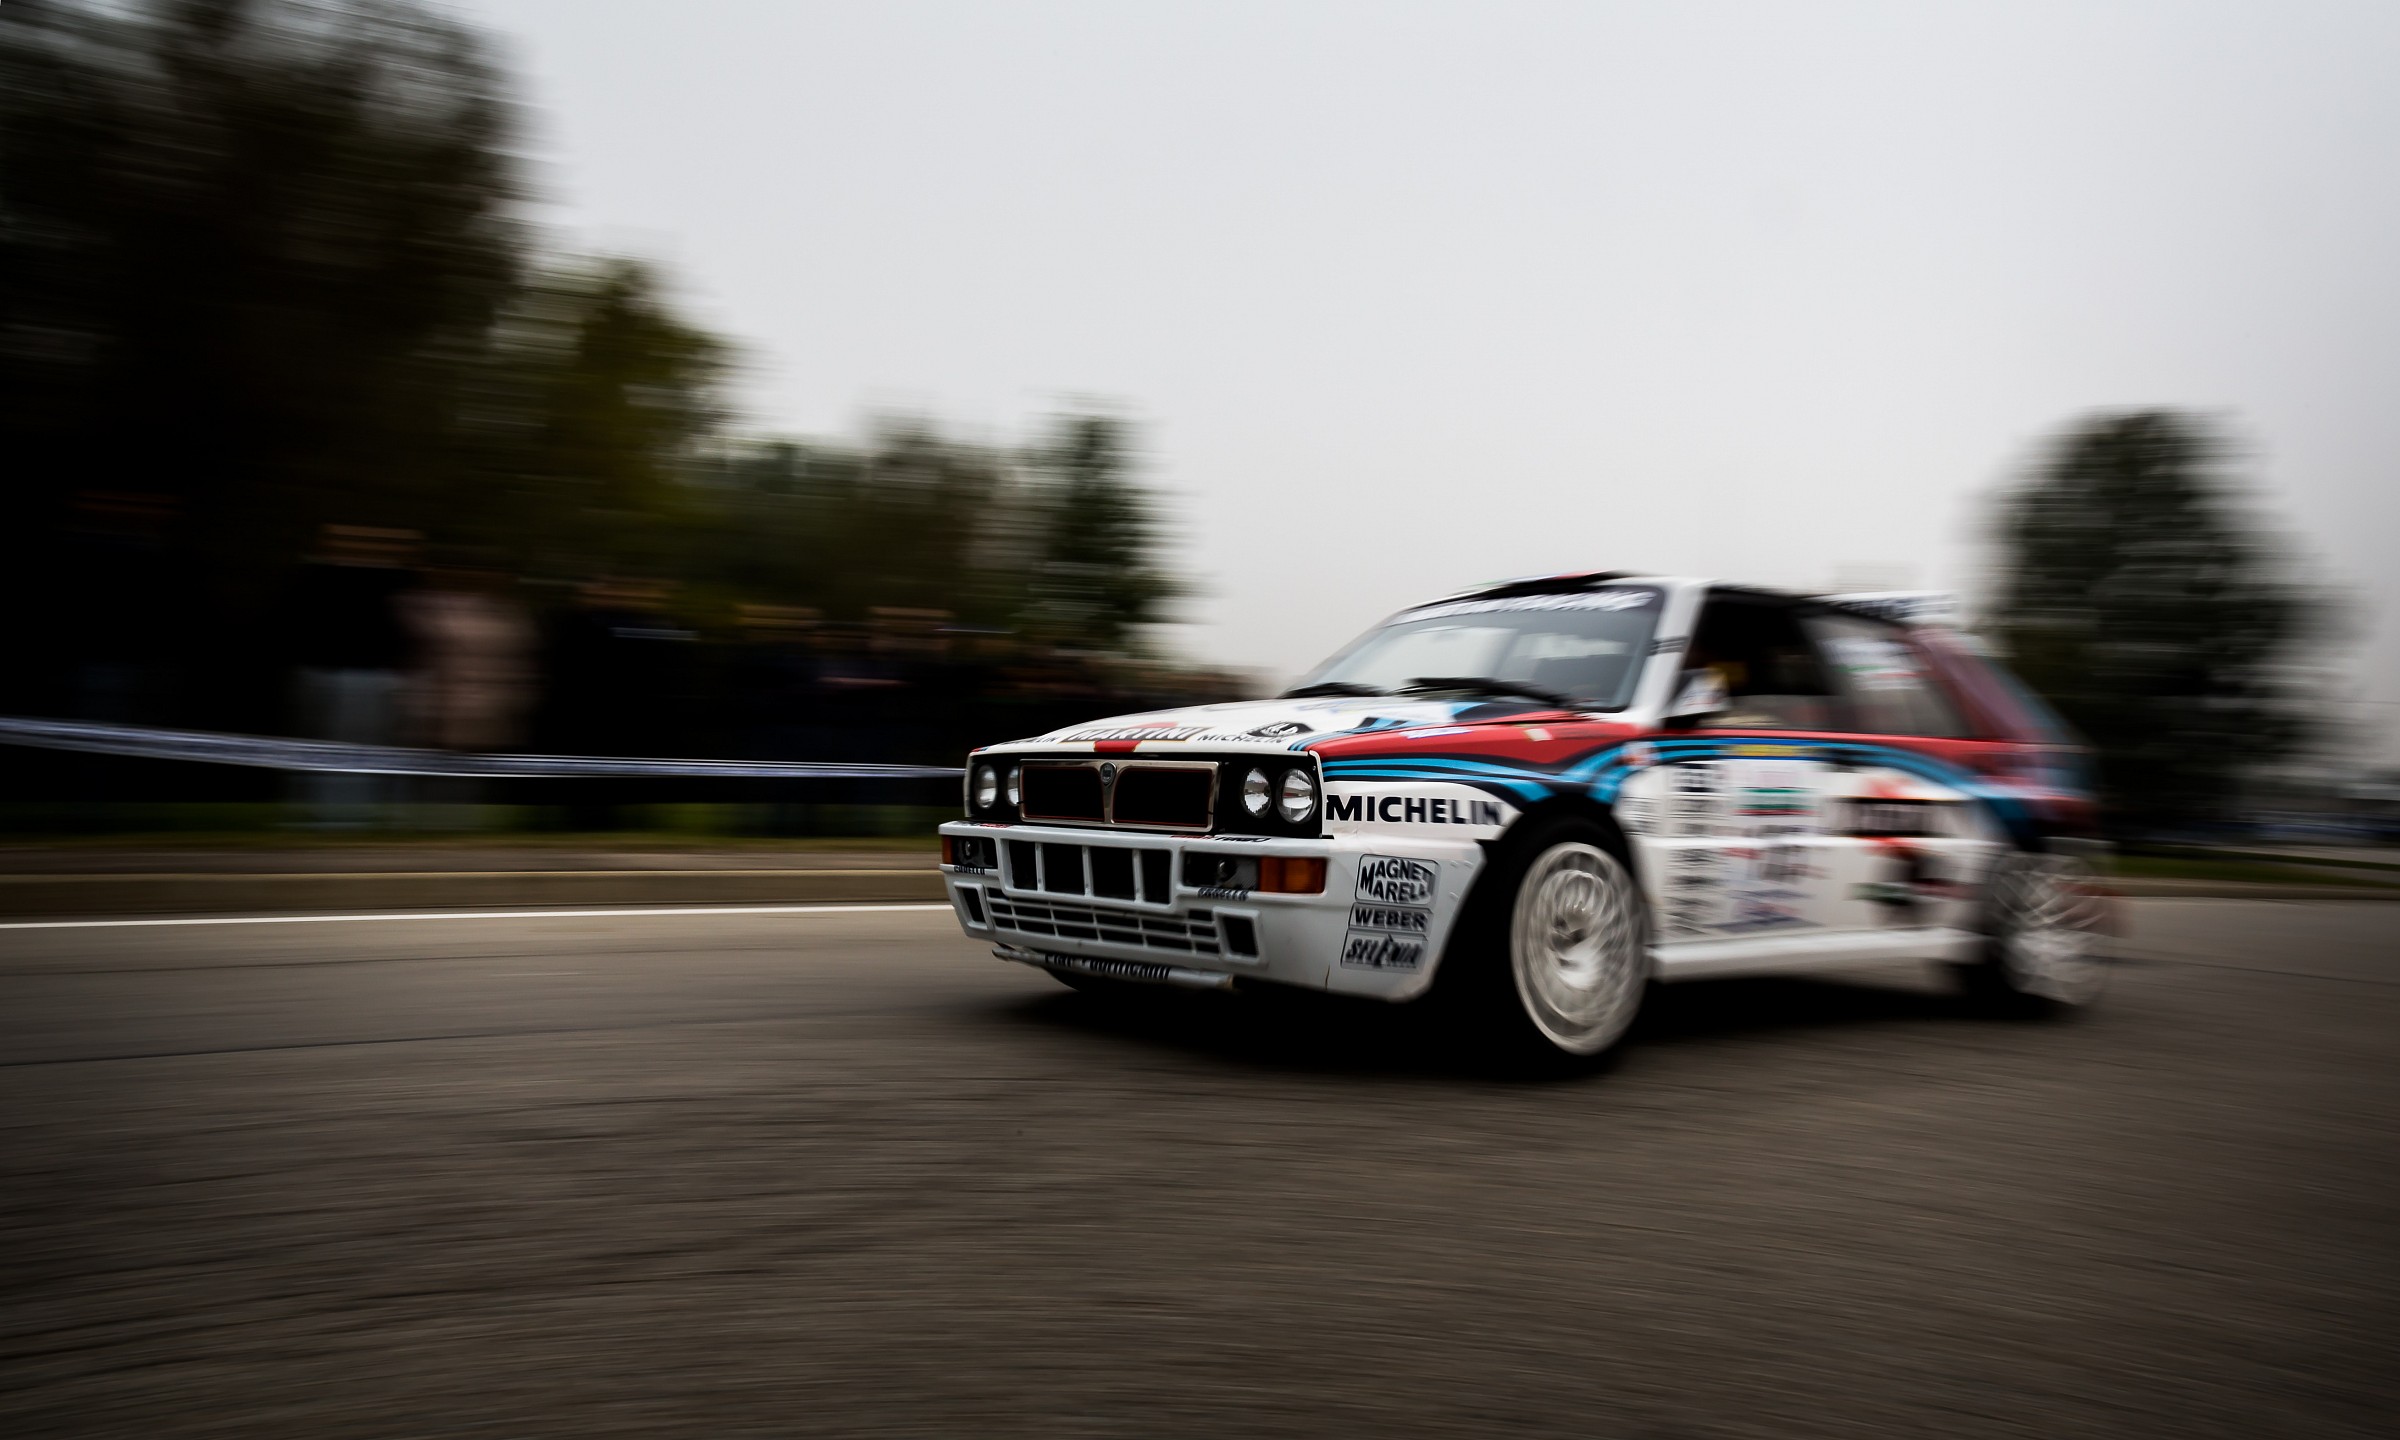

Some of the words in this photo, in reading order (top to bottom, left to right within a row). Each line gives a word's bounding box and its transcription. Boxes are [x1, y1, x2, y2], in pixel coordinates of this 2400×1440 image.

[1063, 727, 1208, 741] MARTINI
[1197, 733, 1285, 744] MICHELIN
[1326, 794, 1503, 825] MICHELIN
[1354, 907, 1428, 932] WEBER
